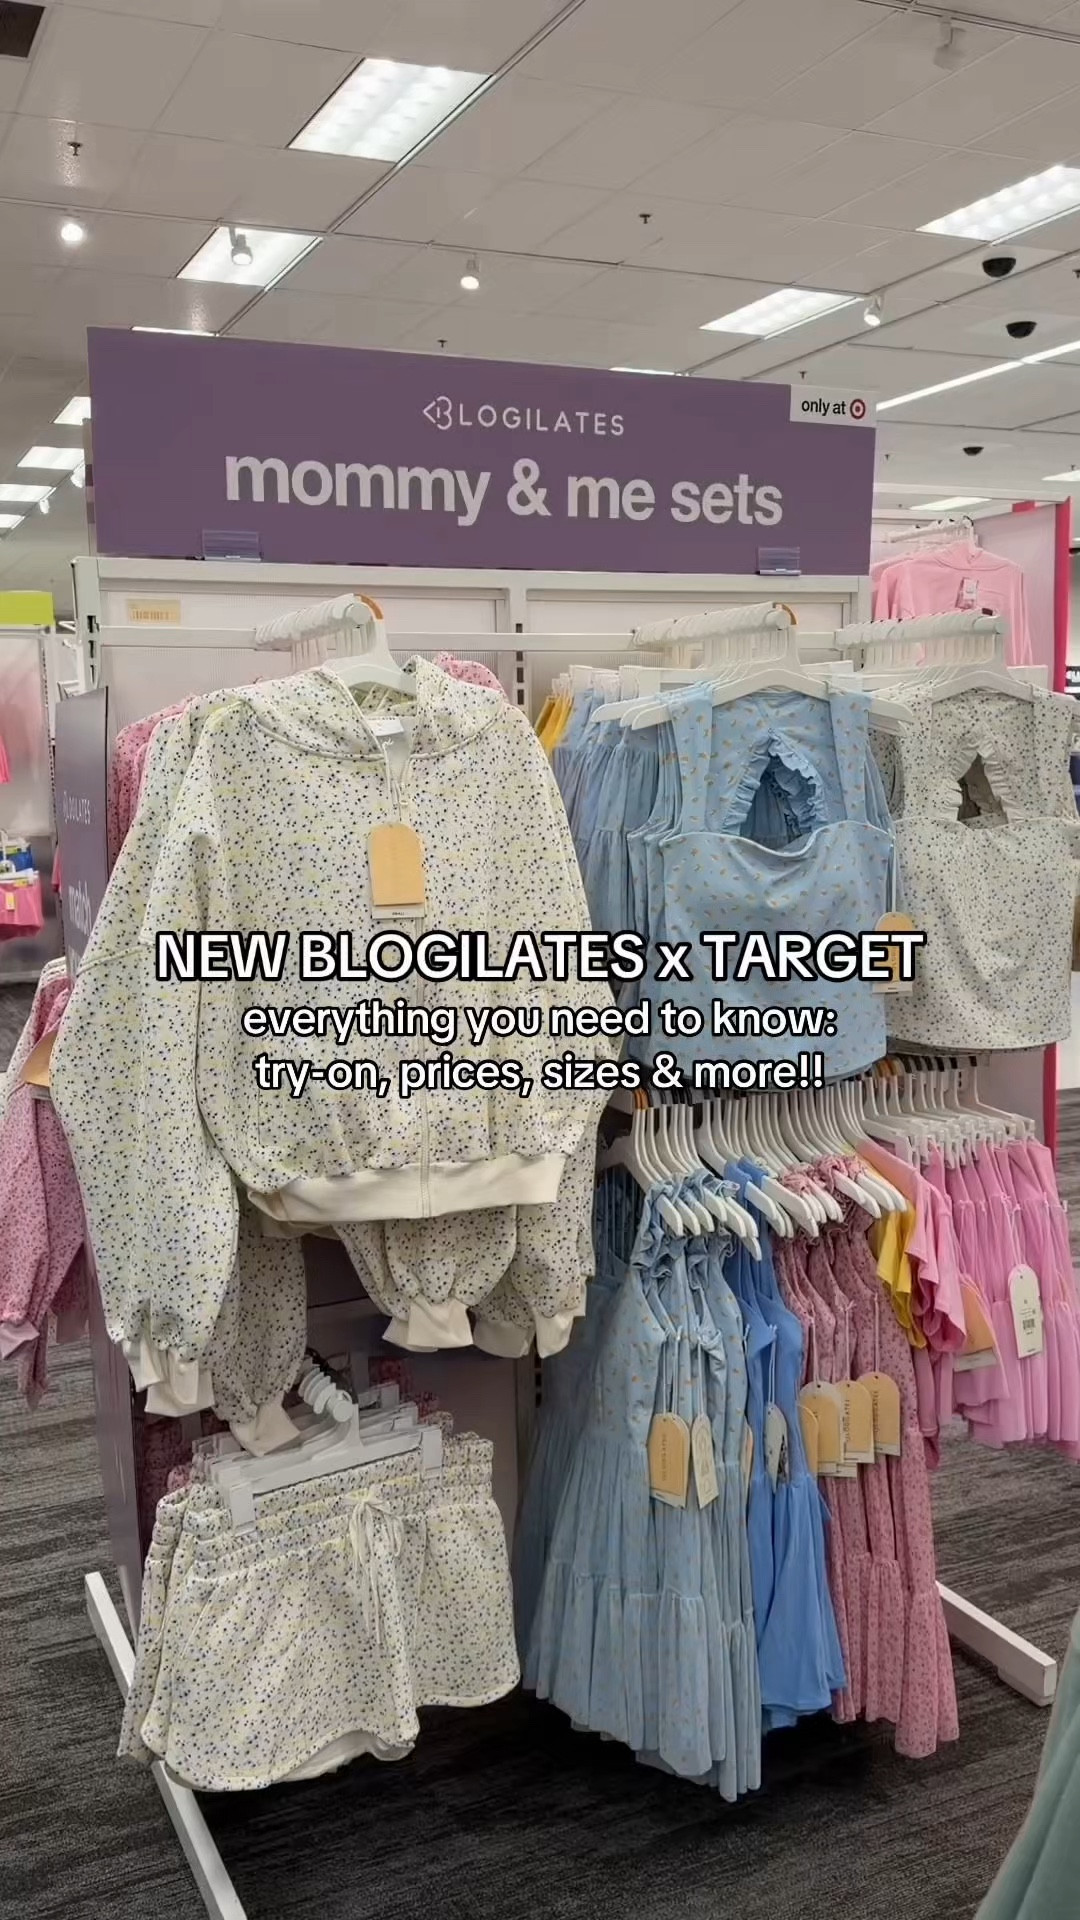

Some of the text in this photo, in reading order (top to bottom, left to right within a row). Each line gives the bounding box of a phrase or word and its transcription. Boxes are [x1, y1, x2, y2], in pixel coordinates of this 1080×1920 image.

[421, 394, 625, 437] BLOGILATES
[801, 397, 847, 417] only at
[225, 455, 783, 527] mommy & me sets
